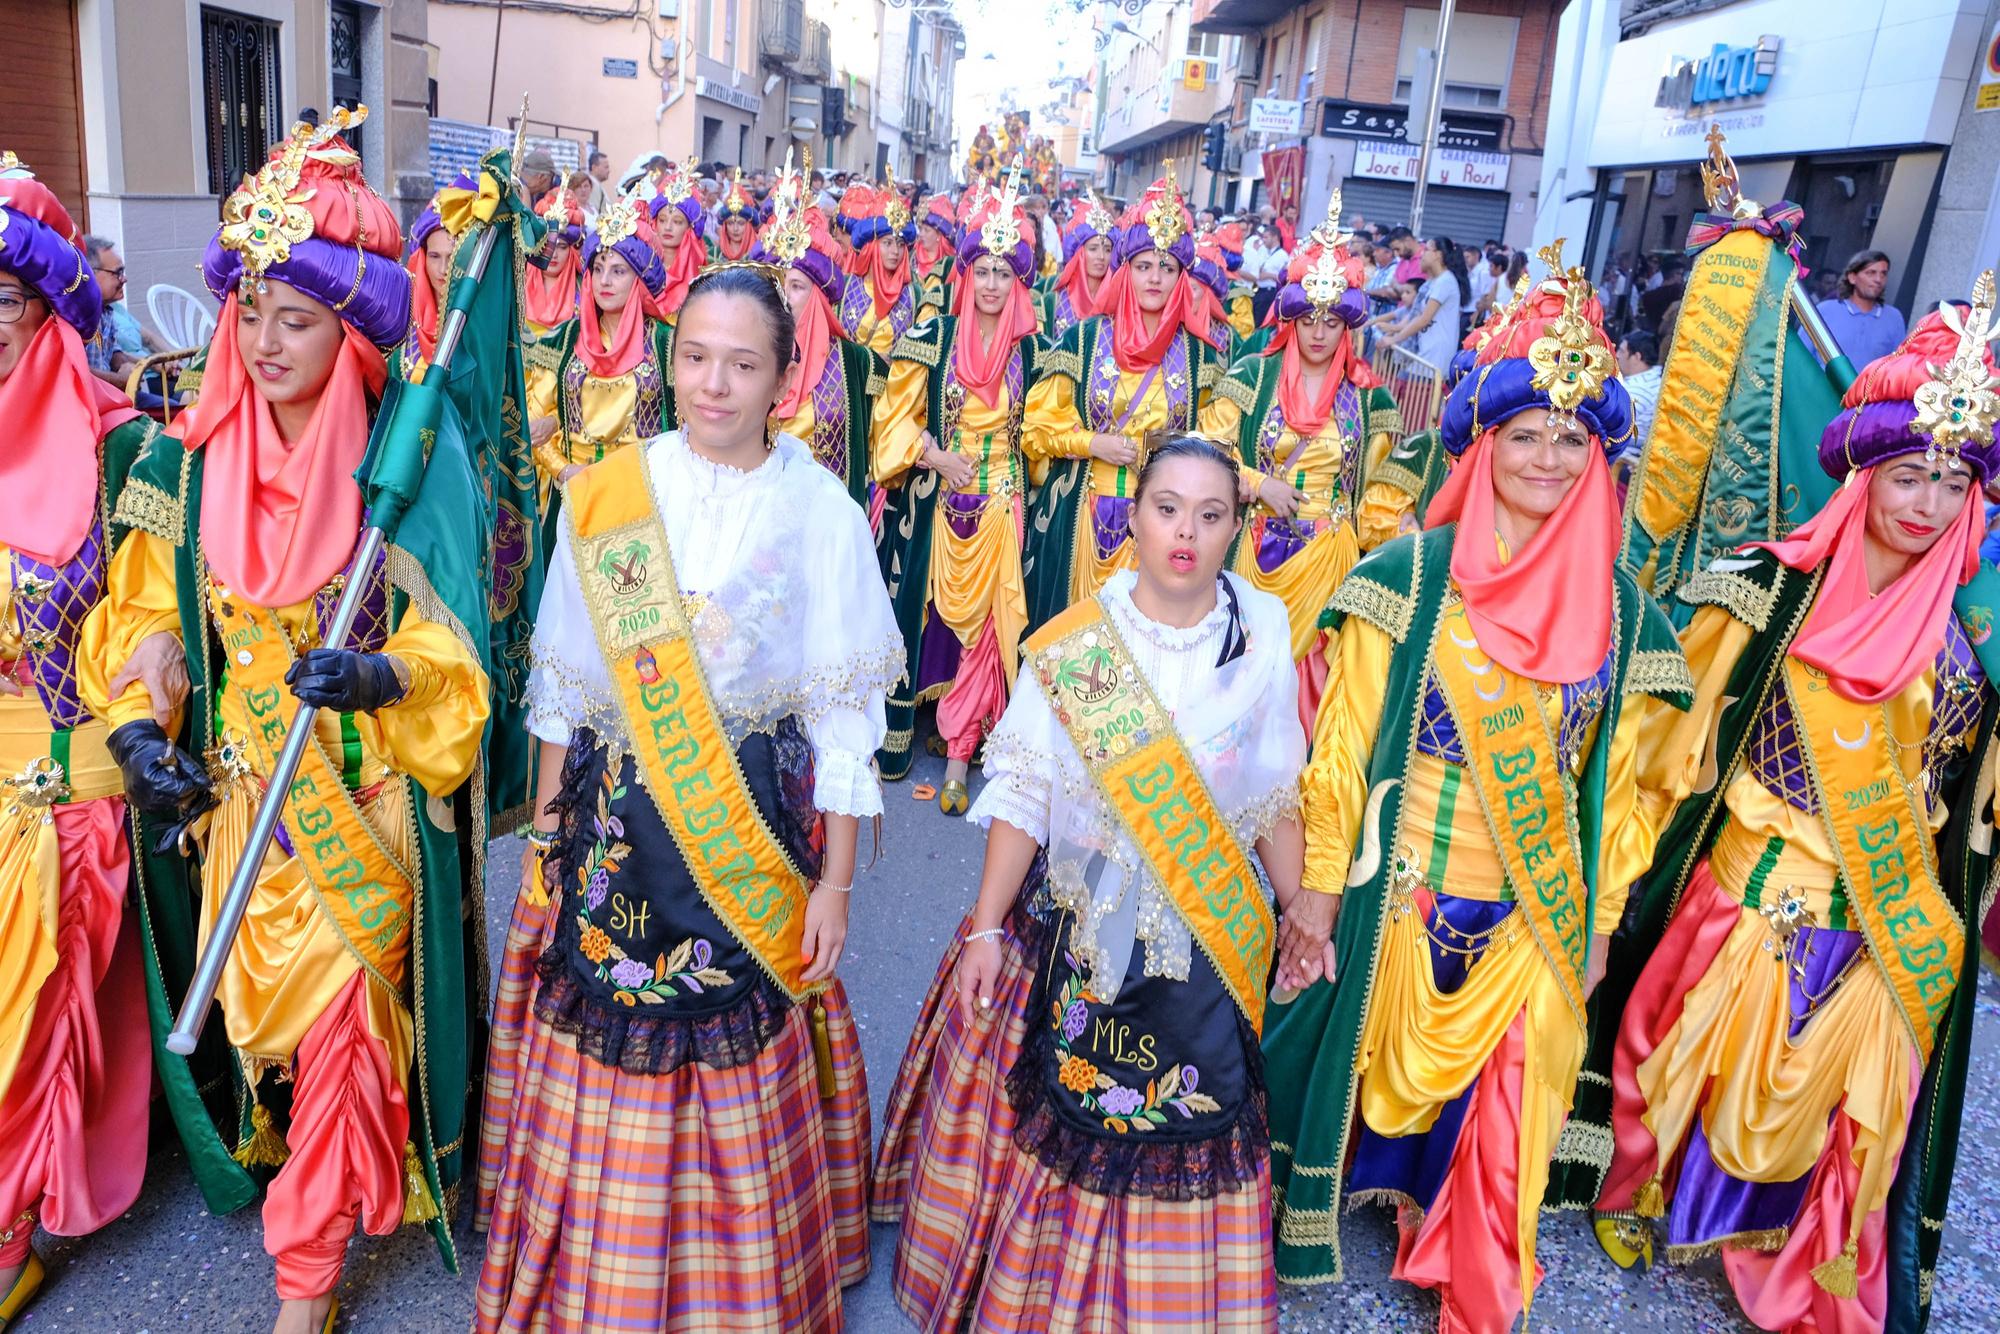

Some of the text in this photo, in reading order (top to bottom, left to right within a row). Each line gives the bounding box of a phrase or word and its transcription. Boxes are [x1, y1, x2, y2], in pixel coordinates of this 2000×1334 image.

[1440, 169, 1449, 184] y
[1463, 163, 1495, 185] Rosi
[1705, 253, 1759, 271] CARGOS
[1697, 295, 1740, 334] MADRINA
[1695, 321, 1728, 350] MAYOR
[1688, 339, 1725, 371] MARINA
[225, 625, 264, 653] 2020
[618, 606, 660, 637] 2020
[1093, 707, 1145, 748] 2020
[1481, 703, 1525, 738] 2020
[243, 681, 402, 930] BEEBERES
[640, 670, 783, 920] BEREBERES
[1843, 777, 1891, 812] 2020
[609, 892, 648, 940] SH
[1092, 1016, 1158, 1072] MLS
